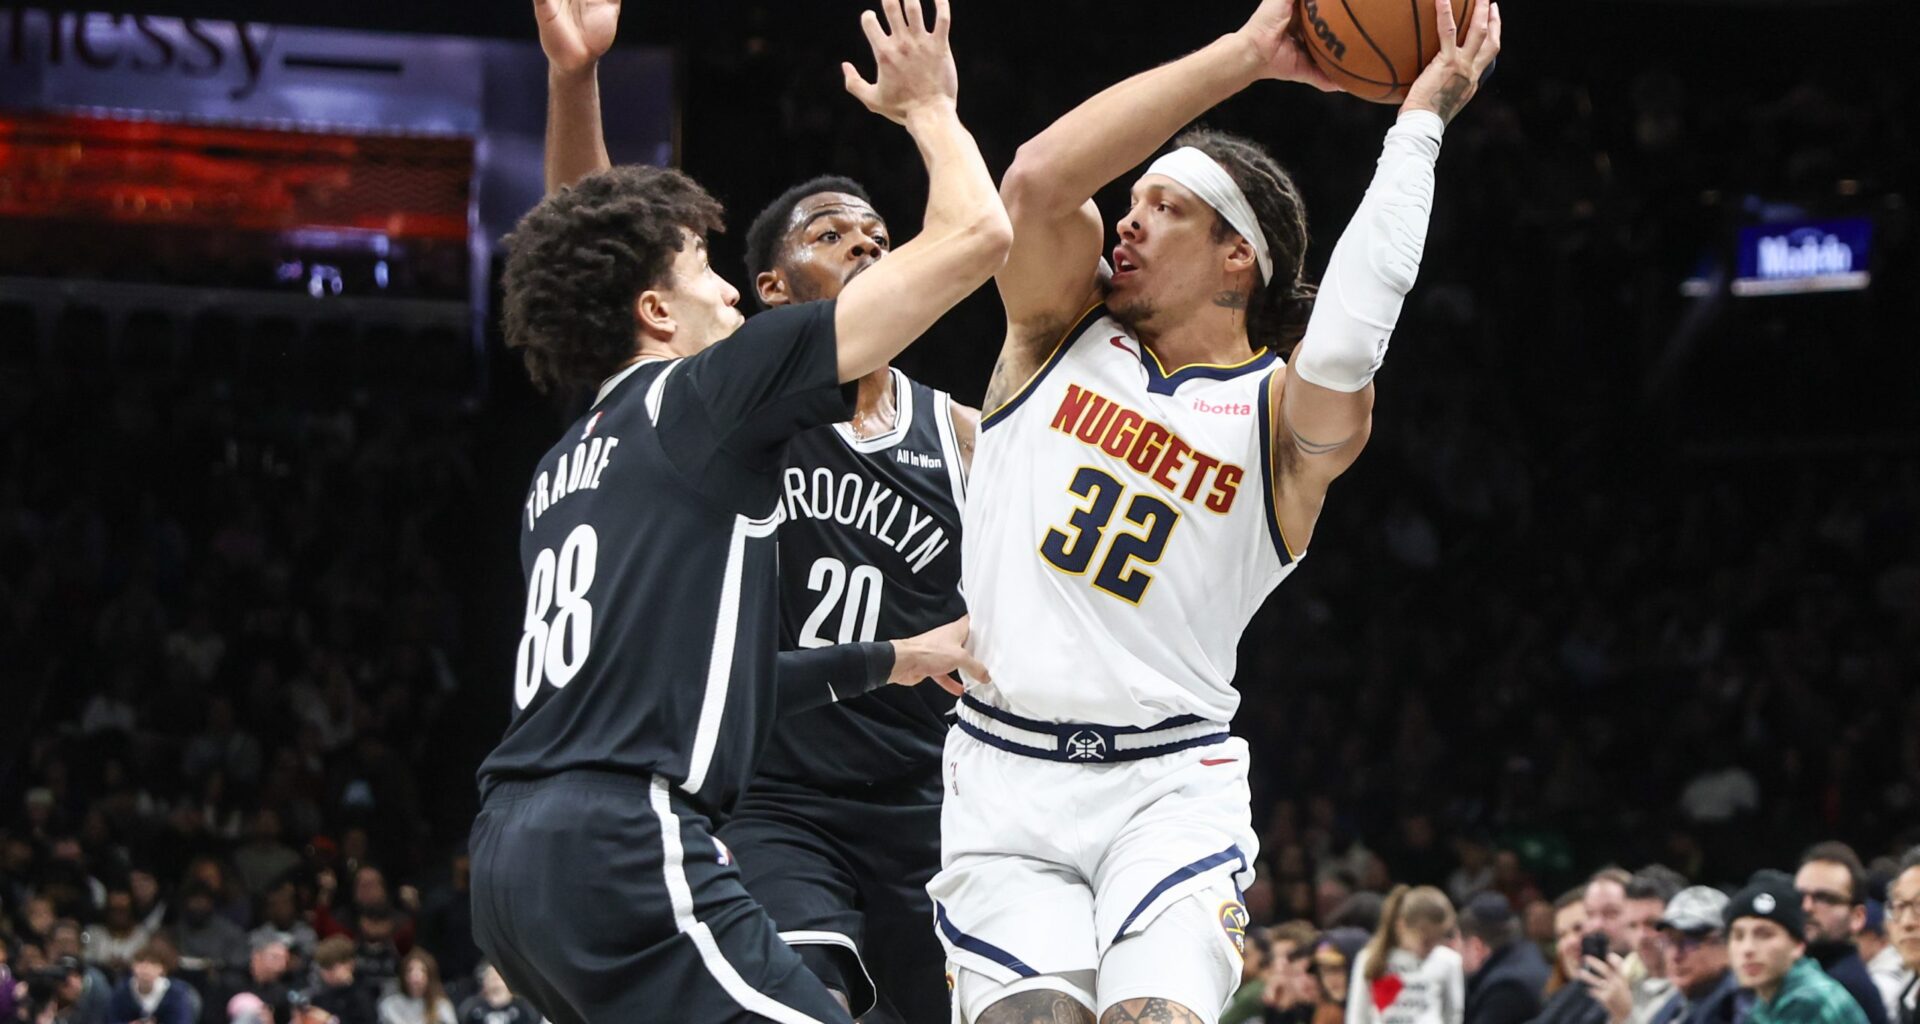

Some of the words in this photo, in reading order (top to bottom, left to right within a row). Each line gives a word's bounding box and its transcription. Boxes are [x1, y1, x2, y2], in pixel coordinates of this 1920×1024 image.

[1050, 384, 1245, 515] NUGGETS
[1193, 398, 1250, 415] ibotta
[526, 436, 619, 532] TRAORE
[897, 449, 909, 464] All
[910, 451, 919, 466] In
[919, 453, 941, 468] Won
[779, 467, 950, 575] ROOKLYN
[1038, 466, 1183, 607] 32
[514, 524, 598, 711] 88
[798, 557, 884, 649] 20
